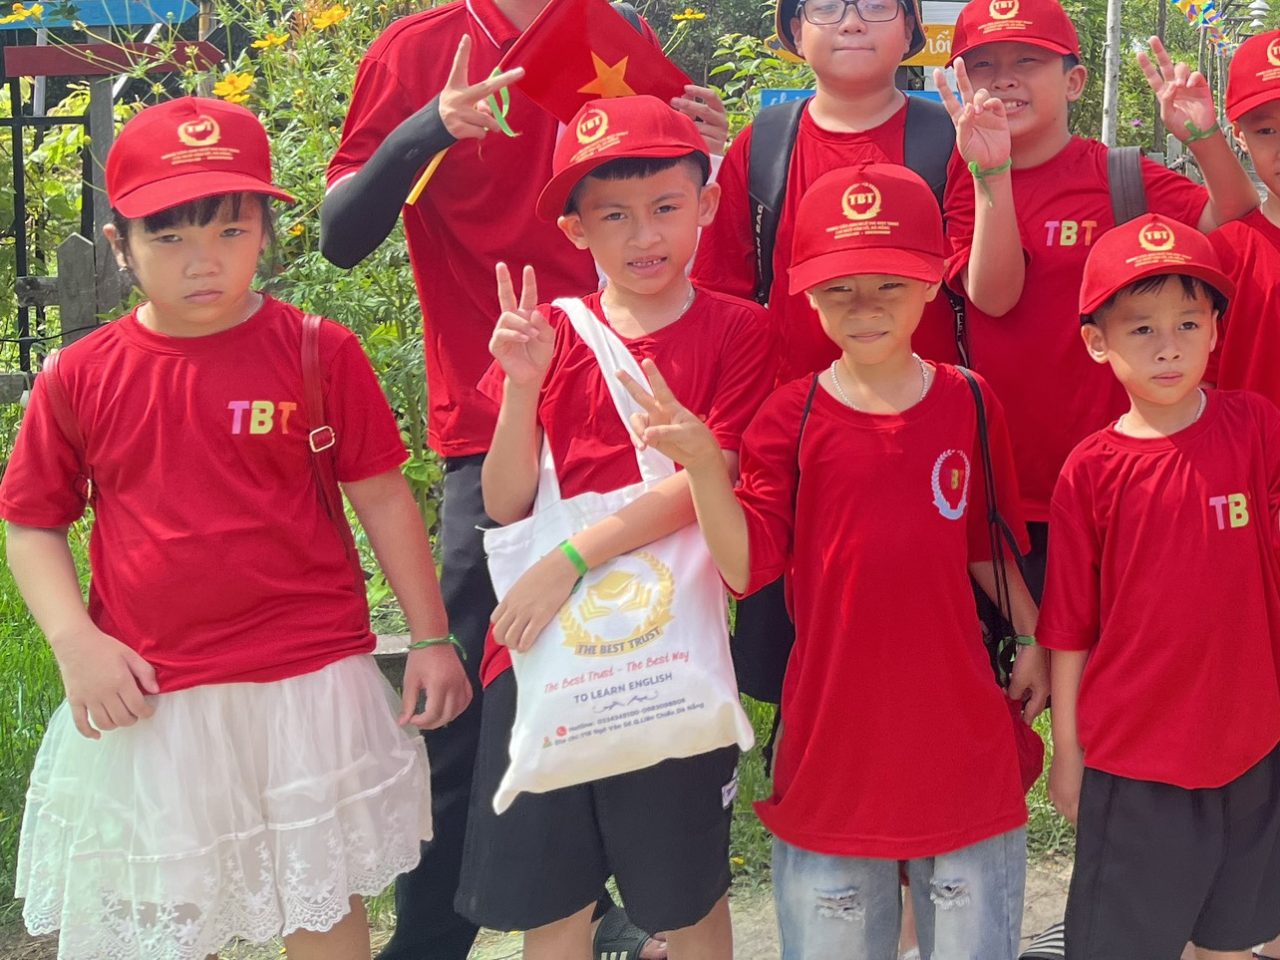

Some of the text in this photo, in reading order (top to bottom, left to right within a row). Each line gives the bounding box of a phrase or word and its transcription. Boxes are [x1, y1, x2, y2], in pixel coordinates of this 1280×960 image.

[848, 192, 874, 206] TBT
[1044, 220, 1098, 247] TBT
[227, 400, 298, 435] TBT
[1208, 492, 1250, 530] TB
[578, 626, 662, 655] THE BEST TRUST
[561, 673, 586, 689] Best
[588, 665, 614, 682] Trust
[626, 661, 644, 673] The
[646, 654, 670, 669] Best
[574, 672, 673, 704] TO LEARN ENGLISH
